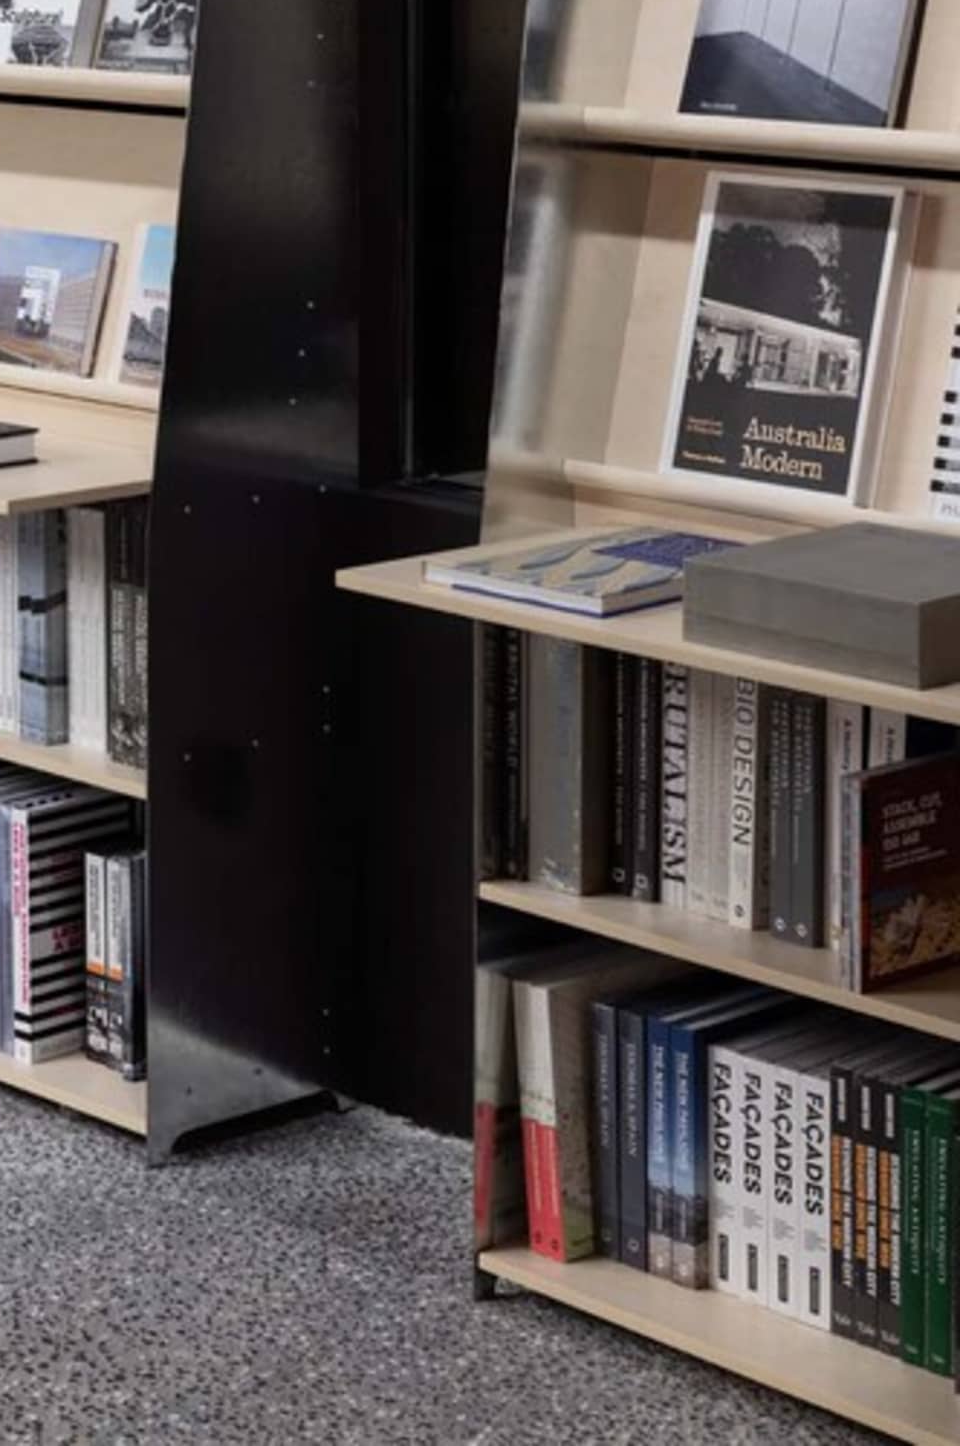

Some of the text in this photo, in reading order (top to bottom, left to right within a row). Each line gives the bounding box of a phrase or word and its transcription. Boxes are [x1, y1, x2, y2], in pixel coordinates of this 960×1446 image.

[739, 444, 824, 482] Modern
[742, 416, 847, 454] Australia
[732, 676, 754, 847] BIO DESIGN
[711, 1062, 733, 1184] FAÇADES
[741, 1071, 762, 1196] FAÇADES
[770, 1080, 793, 1206] FAÇADES
[801, 1090, 825, 1216] FAÇADES
